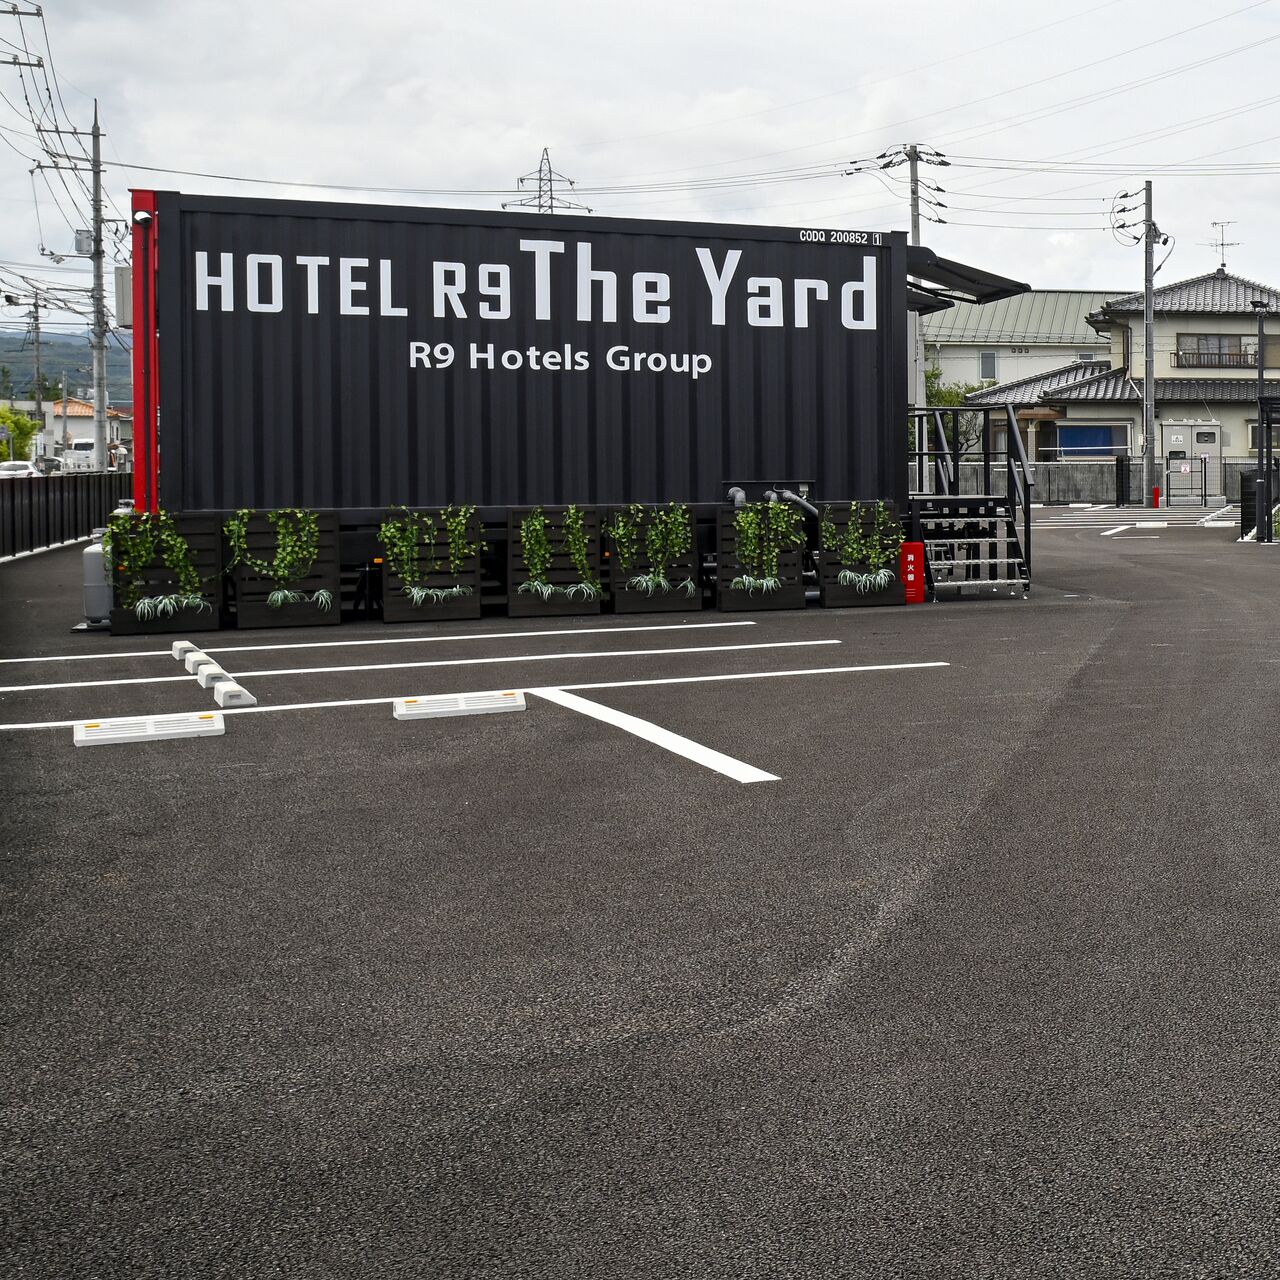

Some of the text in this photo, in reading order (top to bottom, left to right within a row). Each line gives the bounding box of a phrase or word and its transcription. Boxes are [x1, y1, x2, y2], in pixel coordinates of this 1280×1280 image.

[799, 230, 826, 242] CODQ
[830, 231, 868, 244] 200852
[195, 238, 878, 331] HOTEL R9 The Yard
[409, 341, 713, 380] R9 Hotels Group
